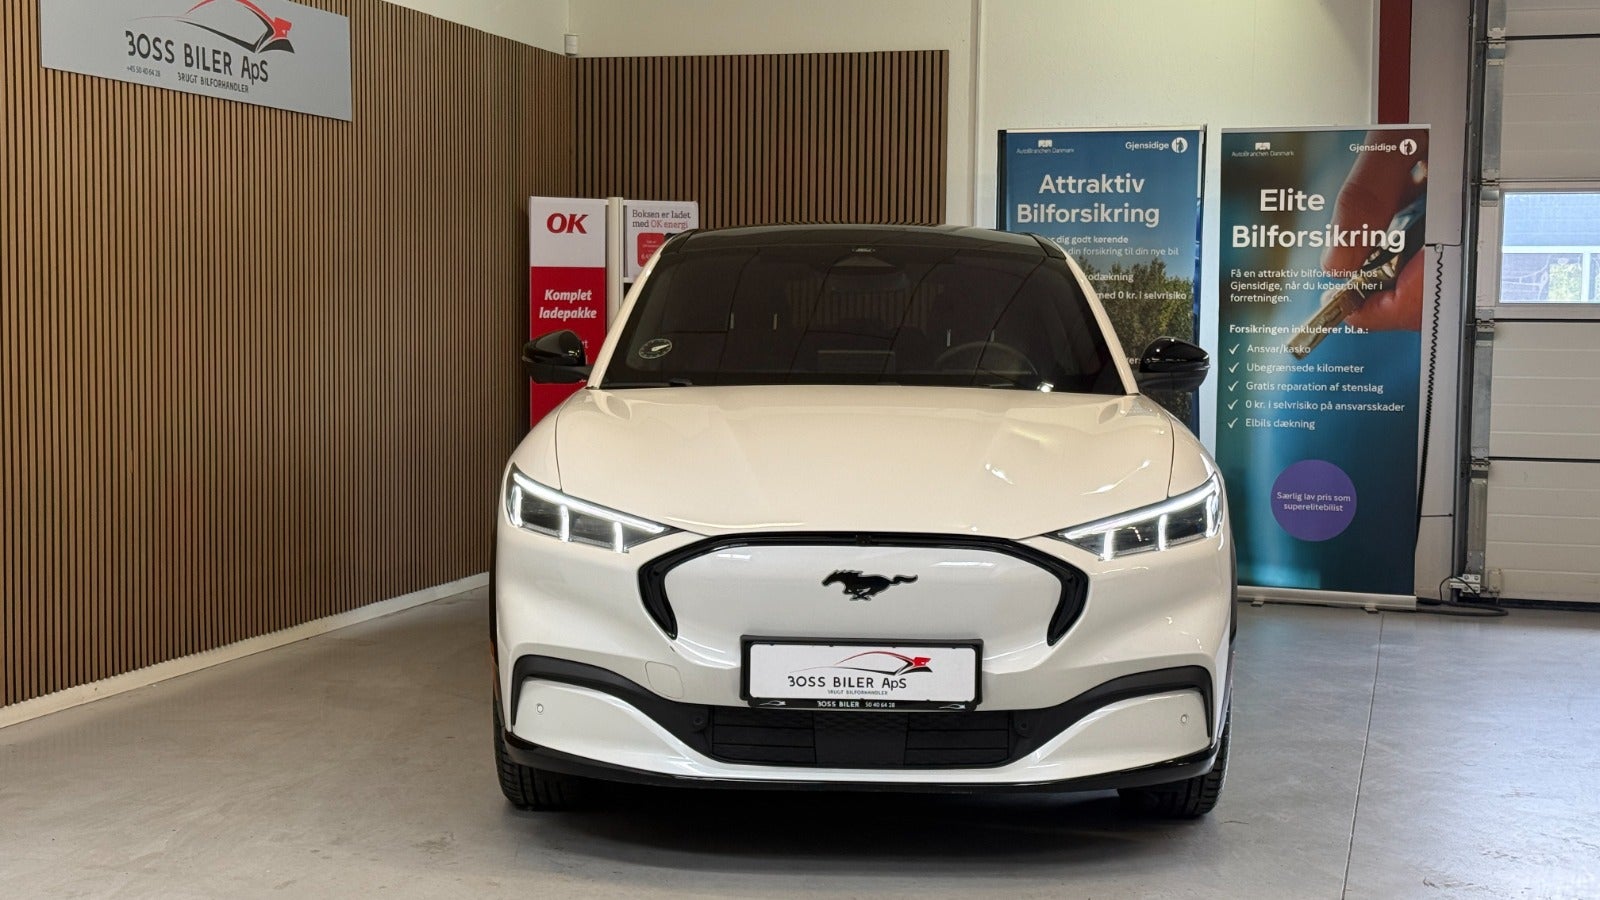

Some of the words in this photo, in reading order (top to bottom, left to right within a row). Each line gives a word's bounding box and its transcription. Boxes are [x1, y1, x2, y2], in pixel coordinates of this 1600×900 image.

[183, 43, 233, 76] BILER
[240, 55, 269, 86] ApS
[200, 77, 249, 94] BILFORHANDLER
[1125, 141, 1169, 151] Gjensidige
[1350, 143, 1397, 152] Gjensidige
[1038, 173, 1145, 194] Attraktiv
[1260, 188, 1325, 212] Elite
[632, 209, 660, 219] Boksen
[661, 211, 670, 219] er
[671, 210, 691, 219] ladet
[1017, 203, 1160, 228] Bilforsikring
[546, 212, 589, 234] OK
[632, 219, 649, 228] med
[650, 220, 662, 228] OK
[664, 220, 688, 230] energi
[1056, 236, 1070, 245] dig
[1072, 236, 1091, 245] godt
[1094, 236, 1128, 244] kørende
[1232, 224, 1406, 253] Bilforsikring
[1068, 247, 1081, 256] din
[1083, 247, 1122, 256] forsikring
[1124, 247, 1134, 256] til
[1136, 247, 1148, 256] din
[1150, 249, 1165, 257] nye
[1168, 247, 1179, 256] bil
[1230, 268, 1242, 278] Få
[1258, 269, 1298, 278] attraktiv
[1301, 269, 1358, 280] bilforsikring
[1360, 269, 1378, 278] hos
[1230, 281, 1282, 292] Gjensidige,
[1285, 280, 1300, 290] når
[1302, 281, 1314, 290] du
[1317, 281, 1345, 290] køber
[1347, 281, 1359, 290] bil
[1361, 282, 1377, 290] her
[1380, 282, 1382, 290] i
[544, 289, 592, 303] Komplet
[1118, 291, 1124, 300] 0
[1126, 291, 1138, 300] kr.
[1144, 291, 1186, 300] selvrisiko
[1230, 293, 1292, 304] forretningen.
[539, 307, 597, 322] ladepakke
[1230, 324, 1290, 336] Forsikringen
[1292, 324, 1342, 334] inkluderer
[1344, 325, 1368, 334] bl.a.:
[1247, 344, 1311, 354] Ansvar/kasko
[1246, 363, 1314, 374] Ubegrænsede
[1317, 364, 1364, 374] kilometer
[1246, 382, 1275, 391] Gratis
[1278, 382, 1328, 393] reparation
[1330, 383, 1340, 392] af
[1342, 384, 1384, 394] stenslag
[1245, 400, 1252, 409] 0
[1254, 400, 1266, 409] kr.
[1274, 400, 1318, 410] selvrisiko
[1320, 400, 1332, 412] på
[1335, 402, 1405, 412] ansvarsskader
[1246, 418, 1272, 428] Elbils
[1274, 419, 1316, 430] dækning
[1277, 492, 1302, 502] Særlig
[1316, 494, 1332, 502] pris
[1284, 504, 1344, 512] superelitebilist
[834, 676, 874, 688] BILER
[882, 678, 907, 692] ApS
